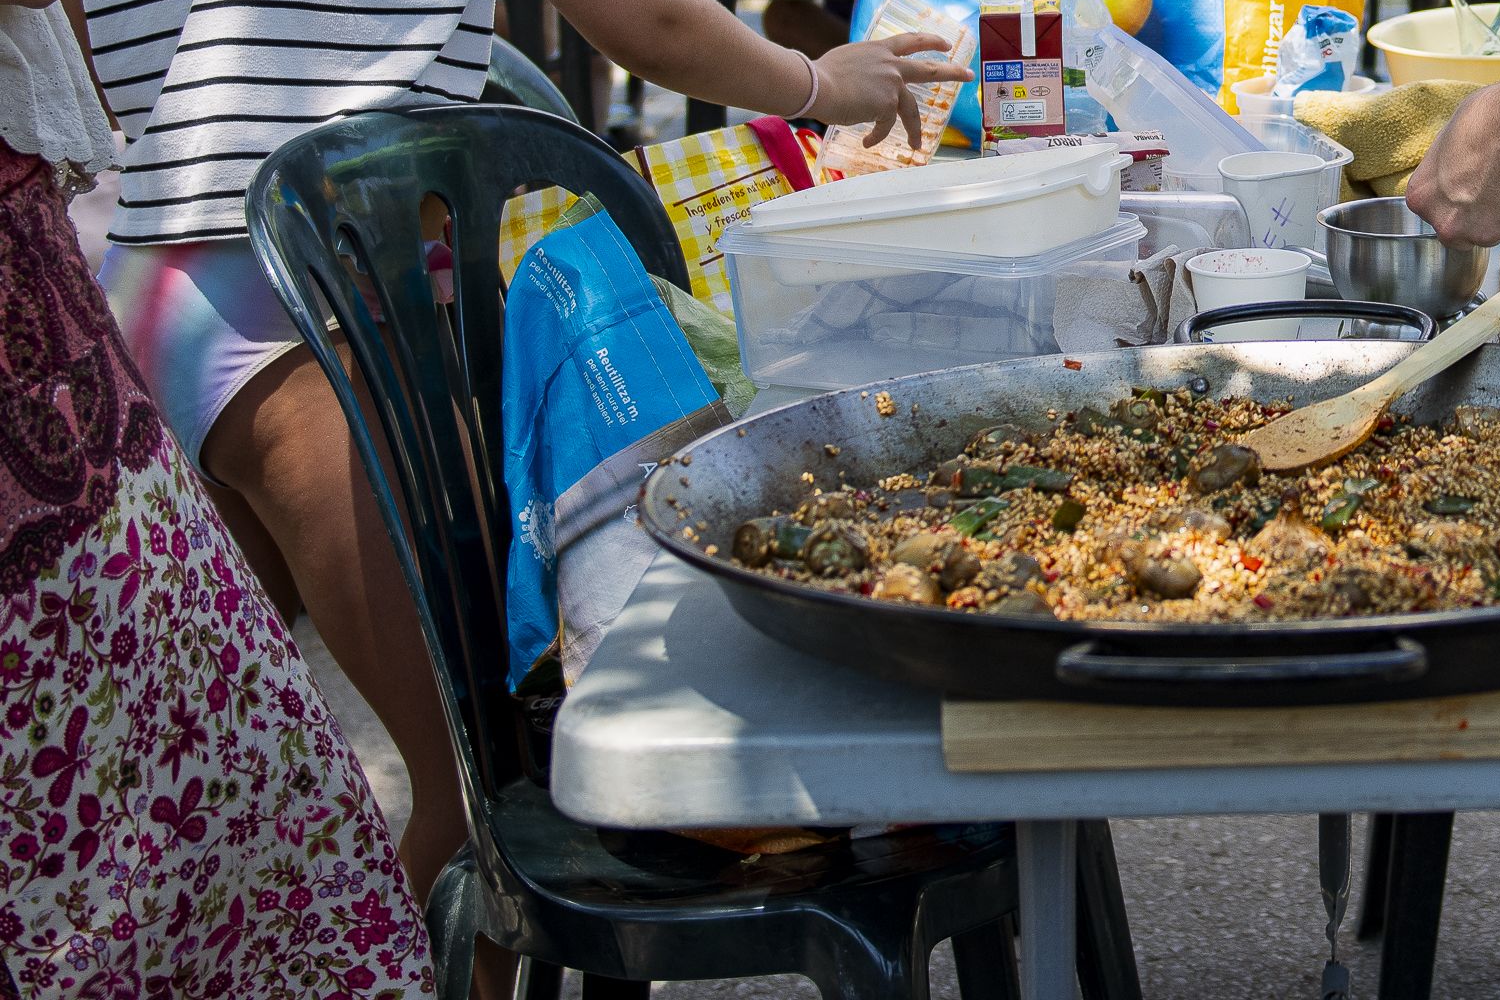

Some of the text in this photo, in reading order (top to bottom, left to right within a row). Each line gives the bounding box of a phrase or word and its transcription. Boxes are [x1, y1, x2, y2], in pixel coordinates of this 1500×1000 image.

[1048, 137, 1083, 147] ARROZ
[684, 174, 781, 217] Ingredientes naturales
[705, 207, 751, 235] y frescos
[529, 261, 544, 274] per
[529, 274, 548, 293] medi
[535, 247, 577, 313] Reutilitza'm,
[583, 371, 614, 428] medi ambient.
[586, 358, 628, 426] per tenir cura del
[596, 347, 638, 421] Reutilitza'm,
